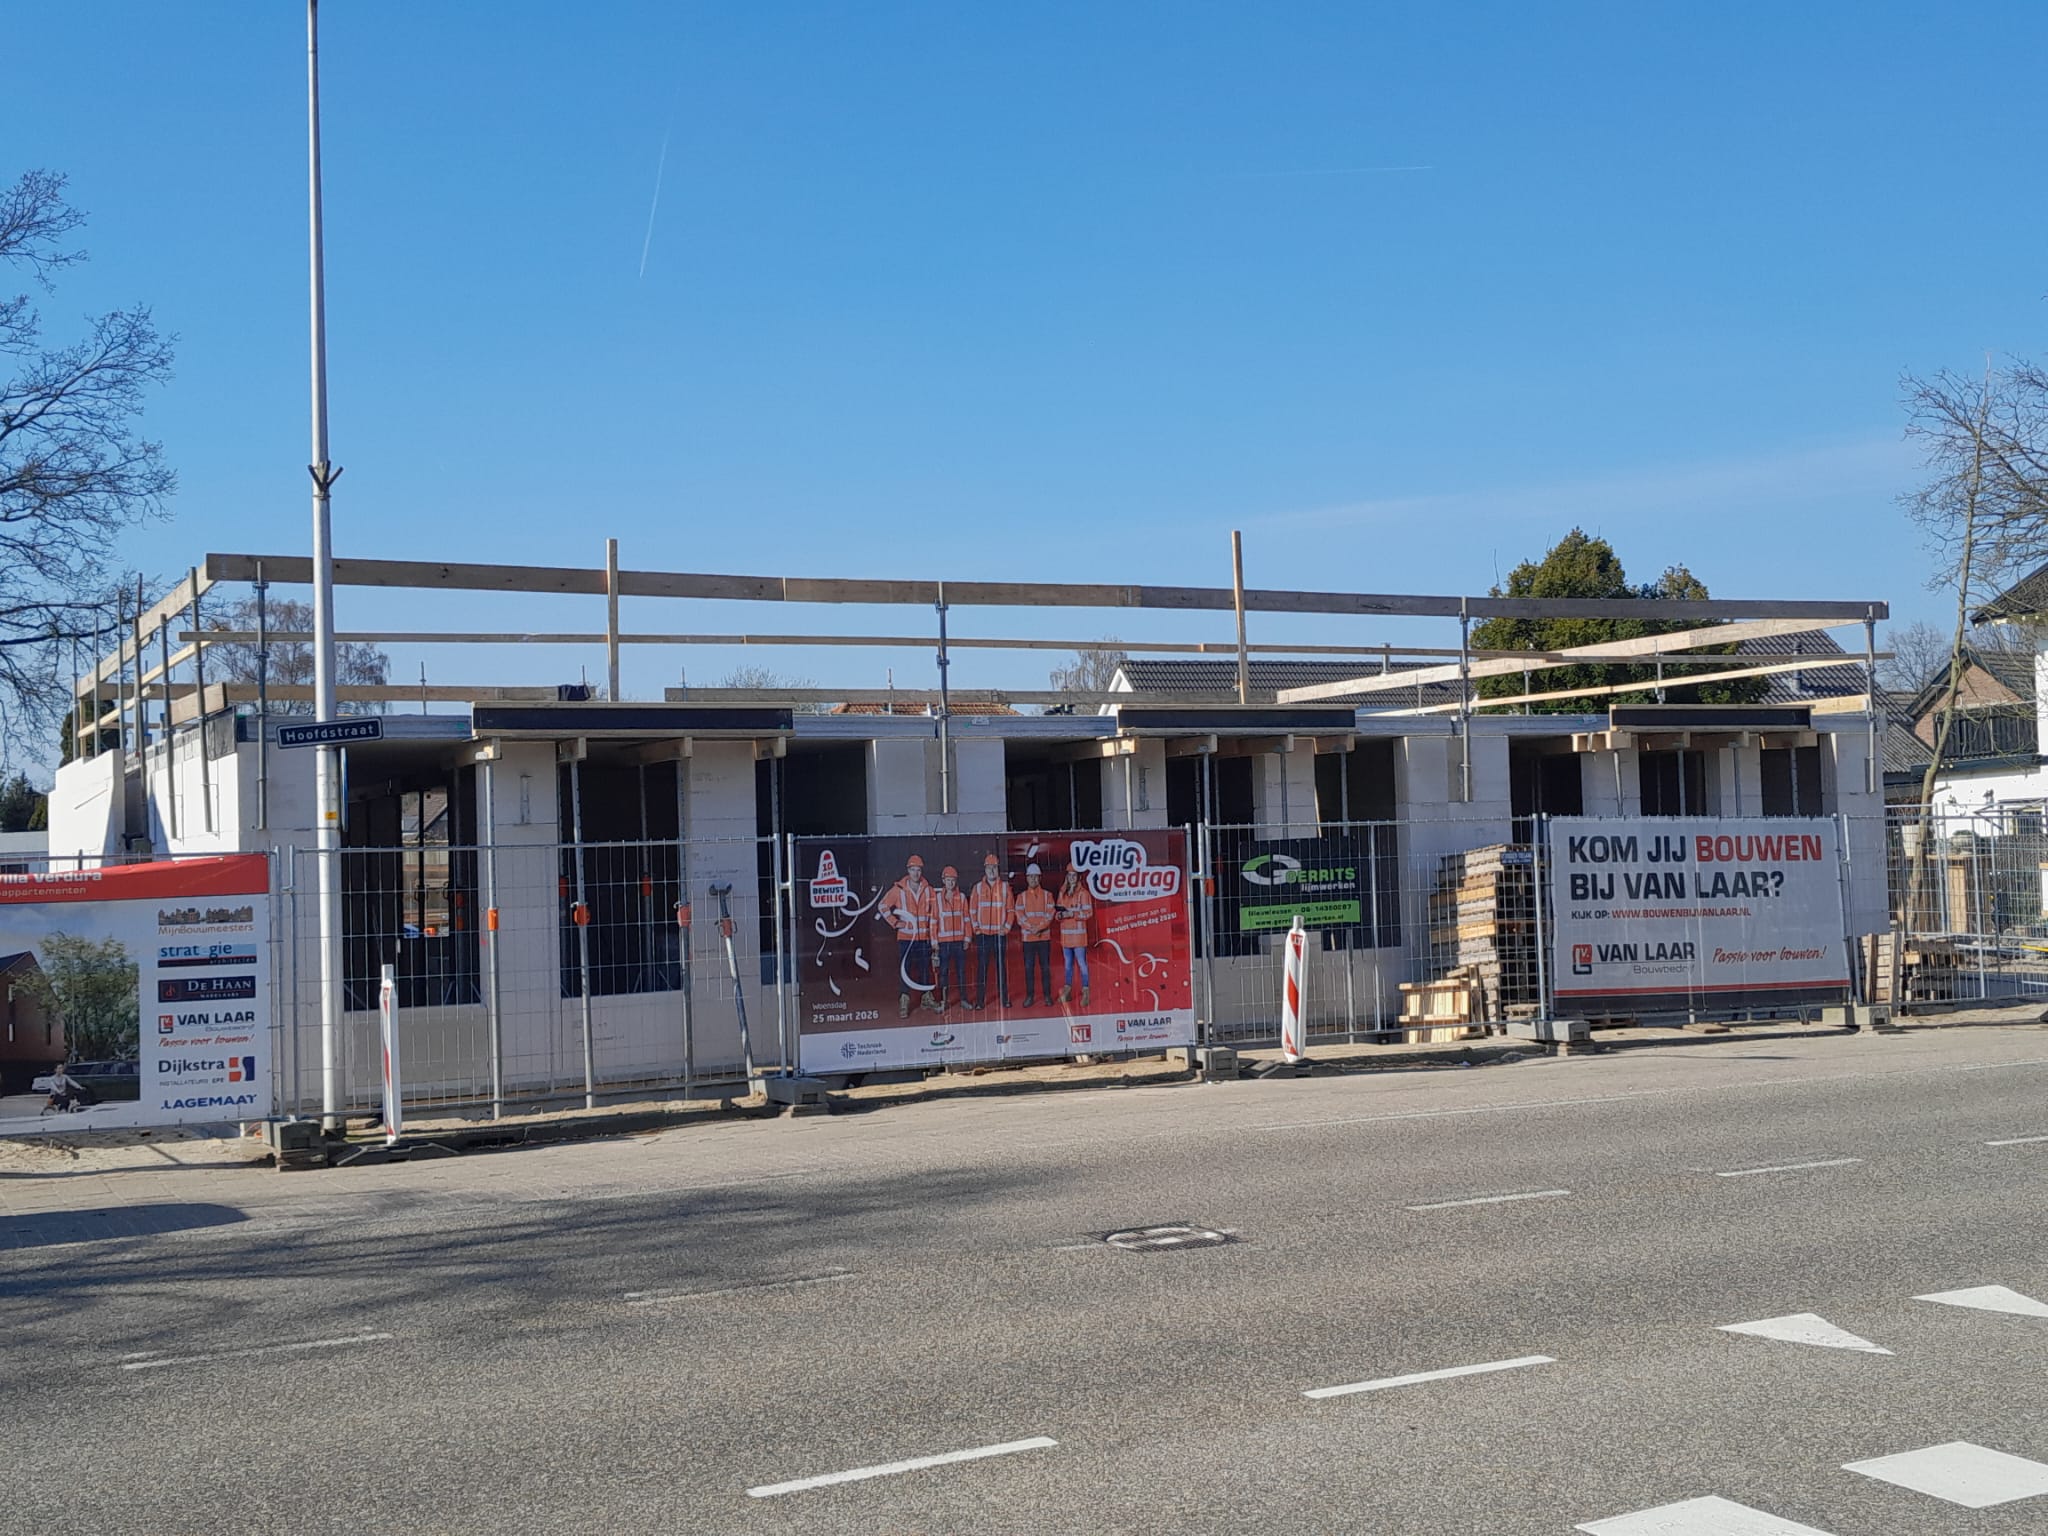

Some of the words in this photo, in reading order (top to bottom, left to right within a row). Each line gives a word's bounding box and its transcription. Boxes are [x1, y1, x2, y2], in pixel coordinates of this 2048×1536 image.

[286, 724, 374, 741] Hoofdstraat
[1569, 835, 1638, 863] KOM
[1647, 835, 1686, 863] JIJ
[1695, 835, 1822, 862] BOUWEN
[1075, 844, 1138, 869] Veilig
[823, 861, 833, 871] 10
[33, 871, 103, 883] Verdura
[1100, 867, 1176, 894] gedrag
[0, 886, 87, 898] appartementen
[812, 886, 845, 895] BEWUST
[1570, 873, 1615, 901] BIJ
[1624, 872, 1687, 900] VAN
[1695, 870, 1785, 899] LAAR?
[813, 894, 845, 904] VEILIG
[1571, 910, 1593, 920] KIJK
[1595, 909, 1611, 920] OP:
[1612, 907, 1752, 919] WWW.BOUWENBIJVANLAAR.NL
[158, 924, 254, 936] MijnBouwmeesters
[1597, 943, 1638, 962] VAN
[1645, 942, 1695, 961] LAAR
[1748, 950, 1776, 964] voor
[1779, 945, 1827, 961] bouwen!
[177, 1013, 209, 1025] VAN
[214, 1011, 255, 1024] LAAR
[812, 1013, 825, 1024] 25
[827, 1012, 853, 1022] maart
[855, 1010, 879, 1021] 2026
[1127, 1018, 1146, 1027] VAN
[1148, 1017, 1172, 1026] LAAR
[158, 1058, 226, 1076] Dijkstra
[161, 1093, 257, 1110] LAGEMAAT
